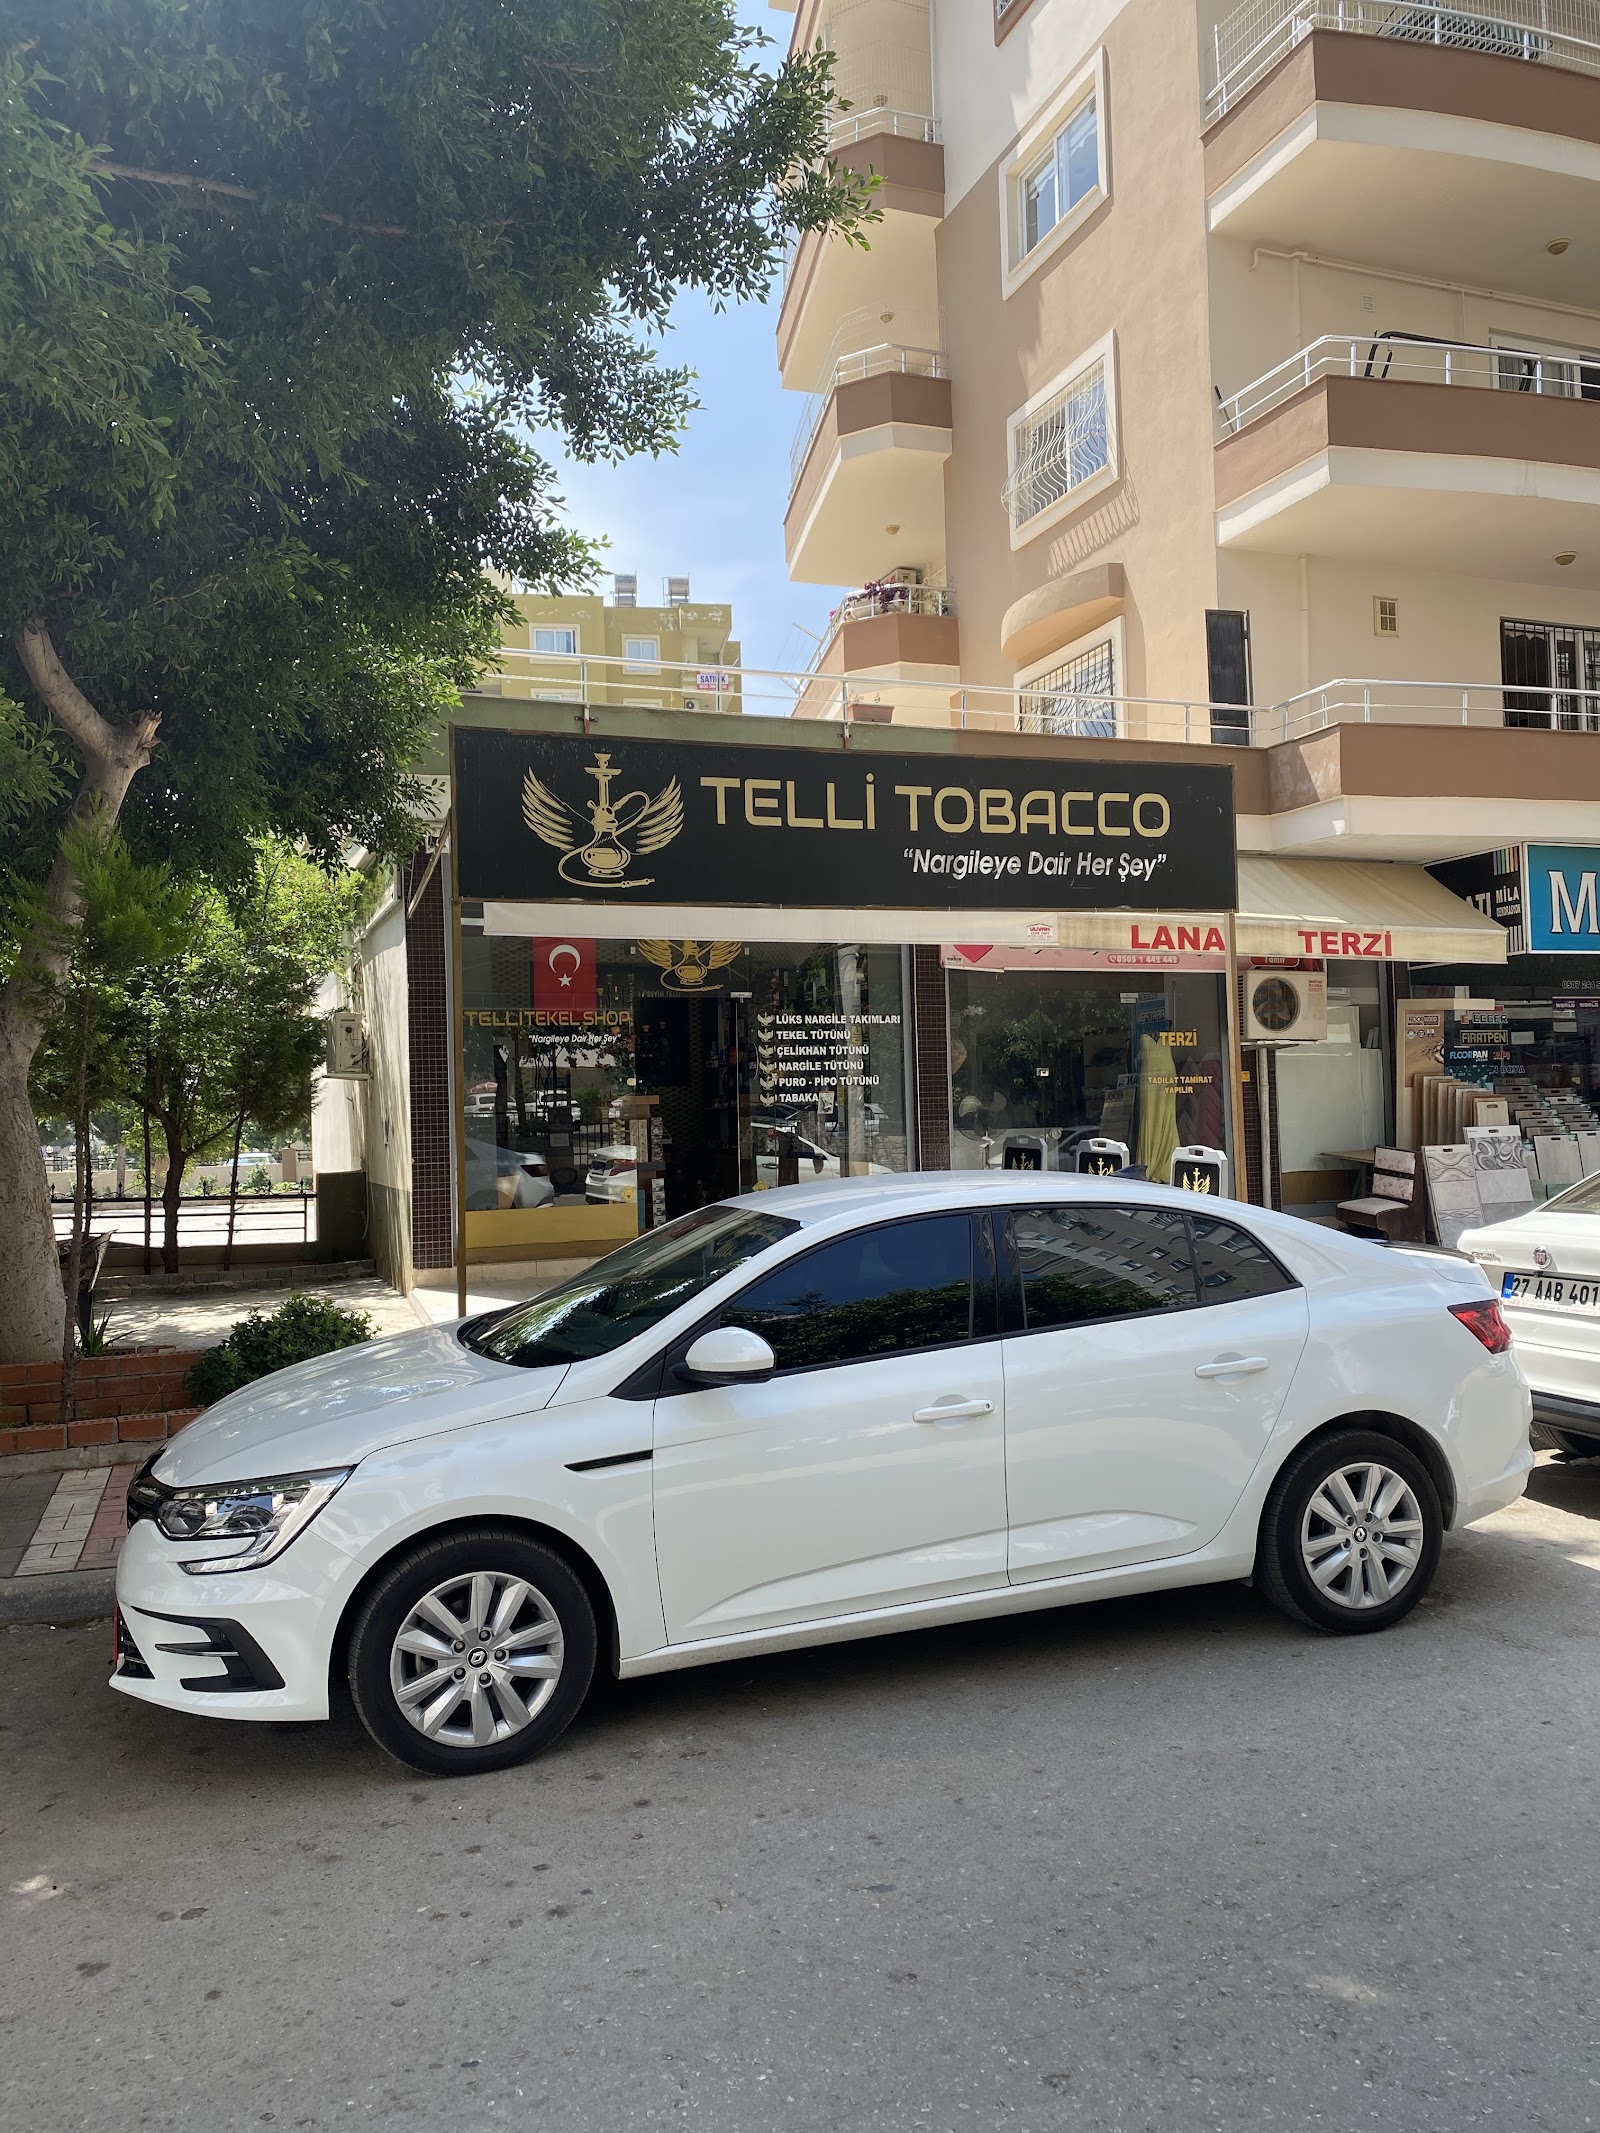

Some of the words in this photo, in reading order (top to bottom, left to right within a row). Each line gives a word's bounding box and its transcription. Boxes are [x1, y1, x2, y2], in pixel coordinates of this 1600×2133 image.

[700, 675, 726, 683] SATIK
[700, 772, 876, 830] TELLİ
[894, 785, 1171, 838] TOBACCO
[1027, 850, 1071, 875] Dair
[1076, 851, 1114, 876] Her
[1496, 885, 1520, 904] MİLA
[1547, 870, 1600, 934] M
[1131, 924, 1226, 951] LANA
[1298, 930, 1393, 957] TERZİ
[1116, 955, 1137, 963] 0505
[1145, 955, 1161, 964] 442
[1162, 955, 1178, 964] 442
[776, 1013, 803, 1025] LÜKS
[804, 1013, 847, 1025] NARGİLE
[849, 1014, 901, 1024] TAKIMLARI
[1472, 1013, 1509, 1024] EGGER
[776, 1030, 809, 1040] TEKEL
[810, 1029, 851, 1040] TÜTÜNÜ
[1160, 1029, 1198, 1047] TERZİ
[1461, 1032, 1507, 1044] FIRATPEN
[776, 1045, 827, 1058] ÇELİKHAN
[829, 1044, 870, 1055] TÜTÜNÜ
[1450, 1050, 1489, 1060] FLOORPAN
[778, 1060, 822, 1072] NARGİLE
[823, 1059, 864, 1071] TÜTÜNÜ
[779, 1077, 807, 1087] PURO
[814, 1075, 838, 1087] PİPO
[839, 1075, 880, 1086] TÜTÜNÜ
[1180, 1075, 1213, 1084] TAMİRAT
[1164, 1086, 1194, 1094] YAPILIR
[780, 1093, 819, 1103] TABAKA
[1512, 1277, 1531, 1298] 27
[1535, 1280, 1564, 1302] AAB
[1569, 1284, 1600, 1307] 401
